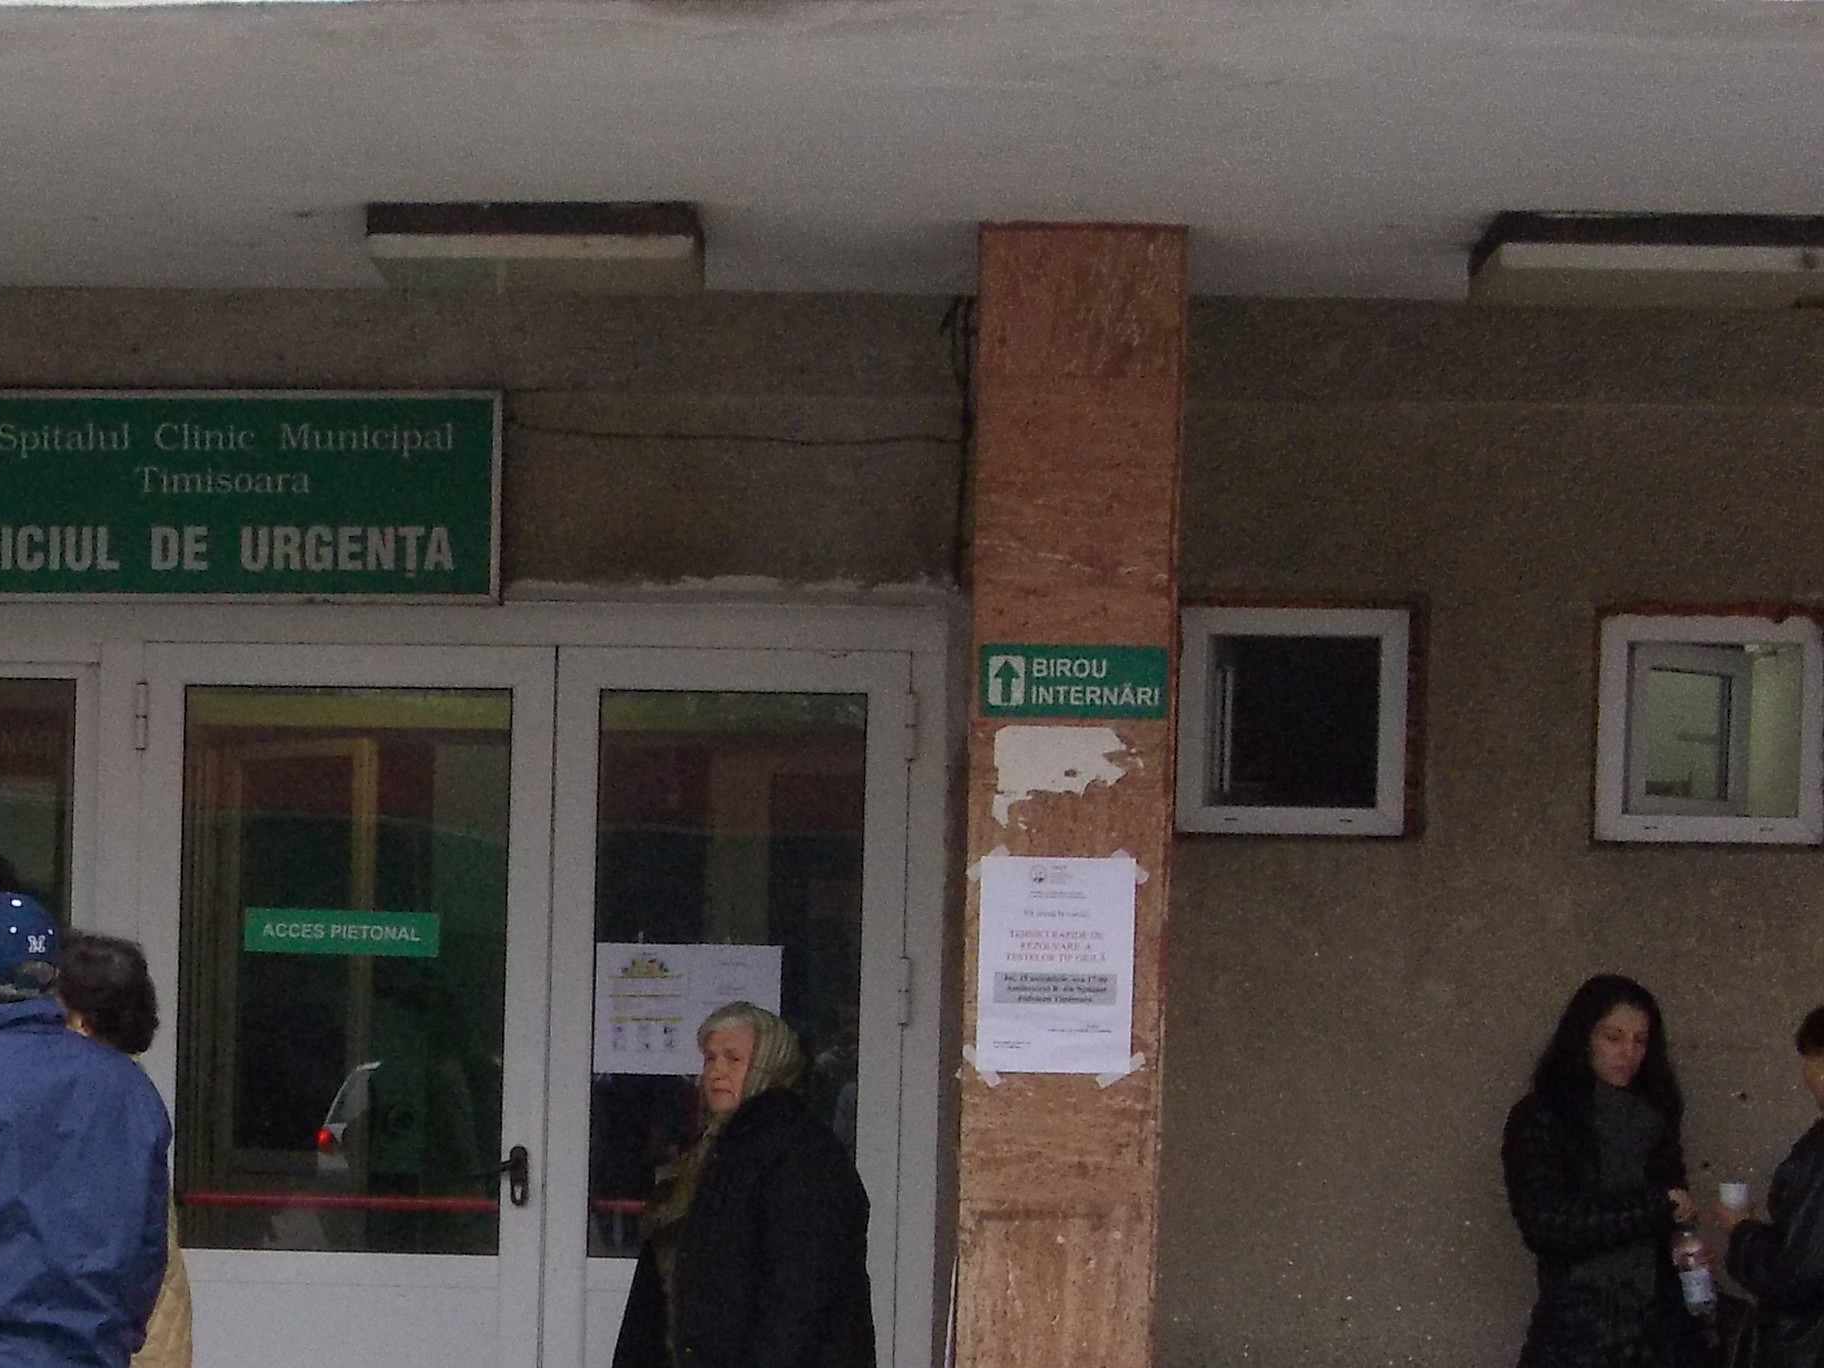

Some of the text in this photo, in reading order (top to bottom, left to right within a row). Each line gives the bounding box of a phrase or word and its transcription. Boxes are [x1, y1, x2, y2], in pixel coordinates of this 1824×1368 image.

[154, 422, 256, 452] Clinic
[280, 422, 453, 460] Municipal
[135, 467, 311, 495] Timisoara
[150, 526, 209, 572] DE
[1032, 658, 1107, 678] BIROU
[1031, 683, 1159, 706] INTERNĂRI
[262, 923, 421, 942] ACCES PIETONAL
